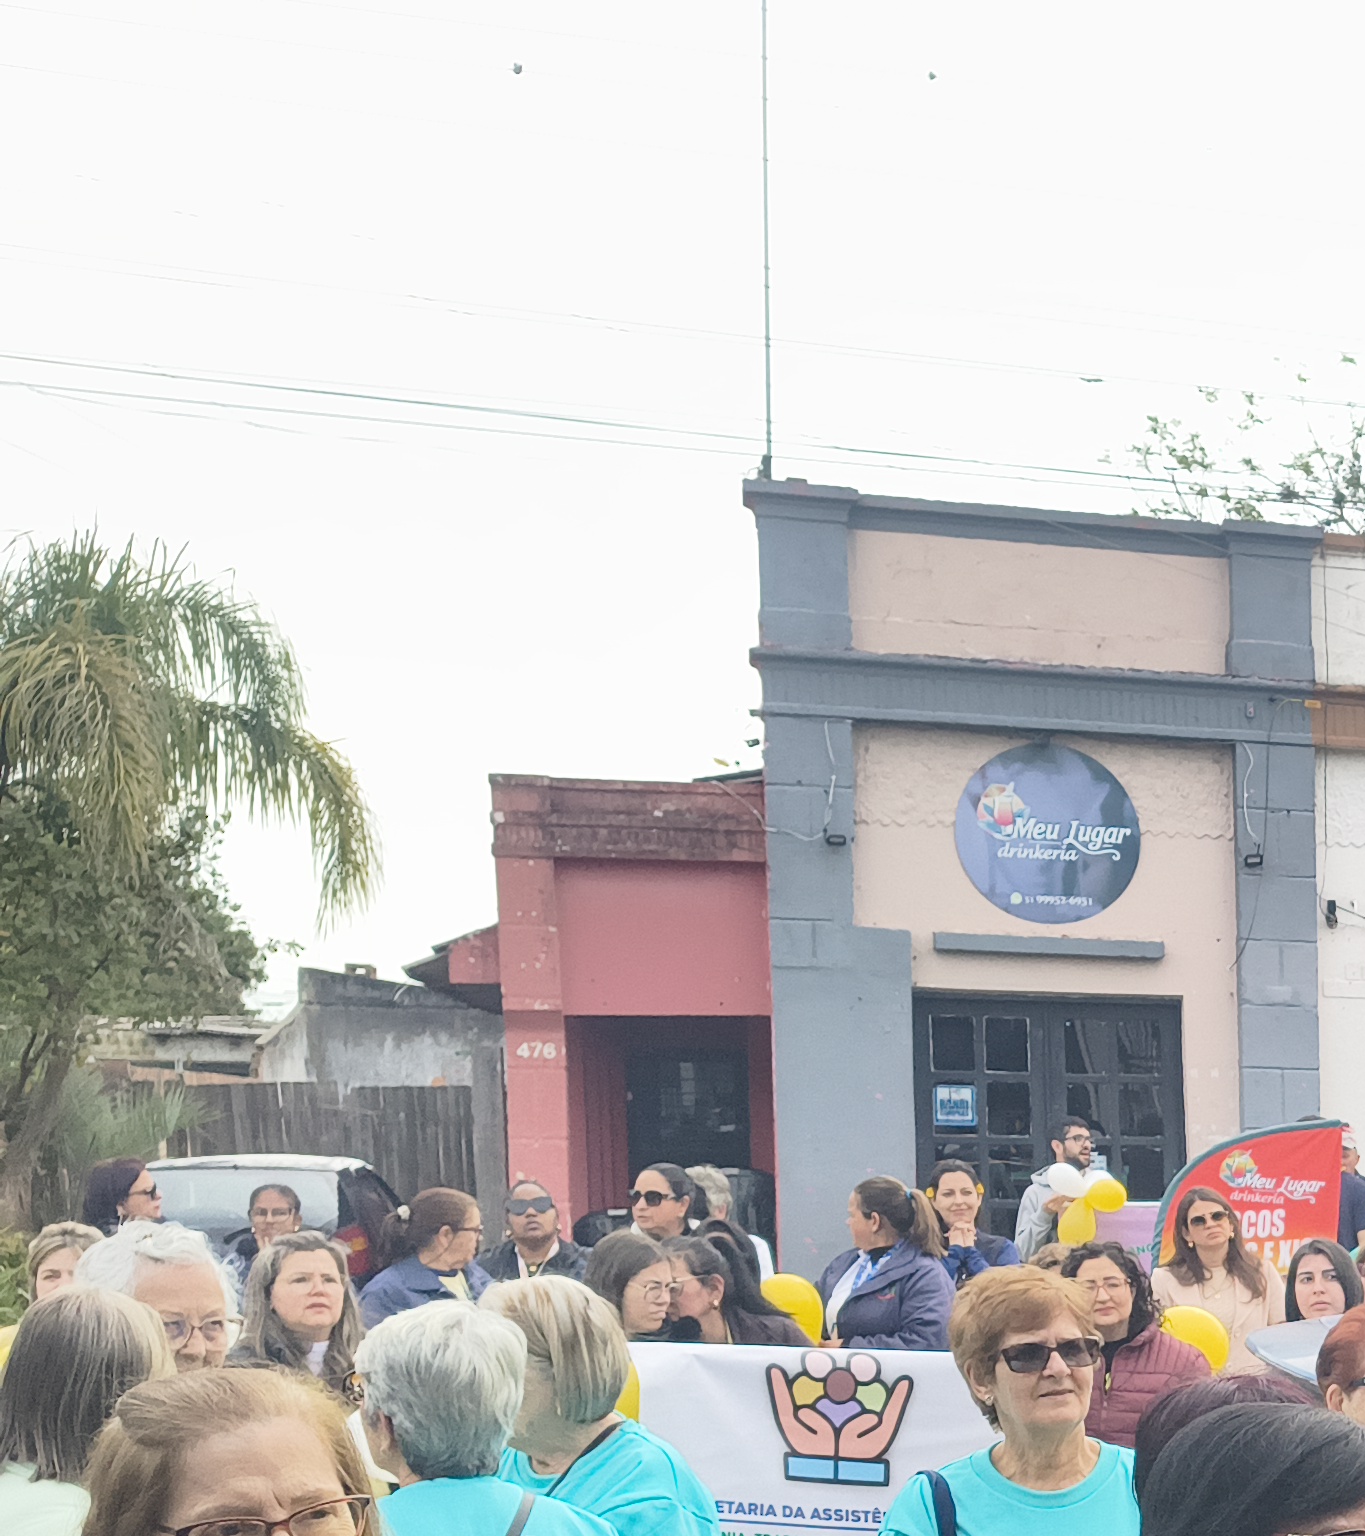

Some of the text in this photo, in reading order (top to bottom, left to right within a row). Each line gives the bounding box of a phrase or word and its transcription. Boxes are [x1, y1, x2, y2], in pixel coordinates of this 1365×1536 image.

[996, 842, 1079, 861] drinkeria
[1013, 817, 1132, 861] Meu Lugar
[516, 1041, 557, 1059] 476
[1229, 1188, 1285, 1205] drinkeria
[1241, 1171, 1326, 1204] Meu Lugar
[1235, 1207, 1287, 1239] COS
[715, 1500, 887, 1525] ETARIA DA ASSISTÊ
